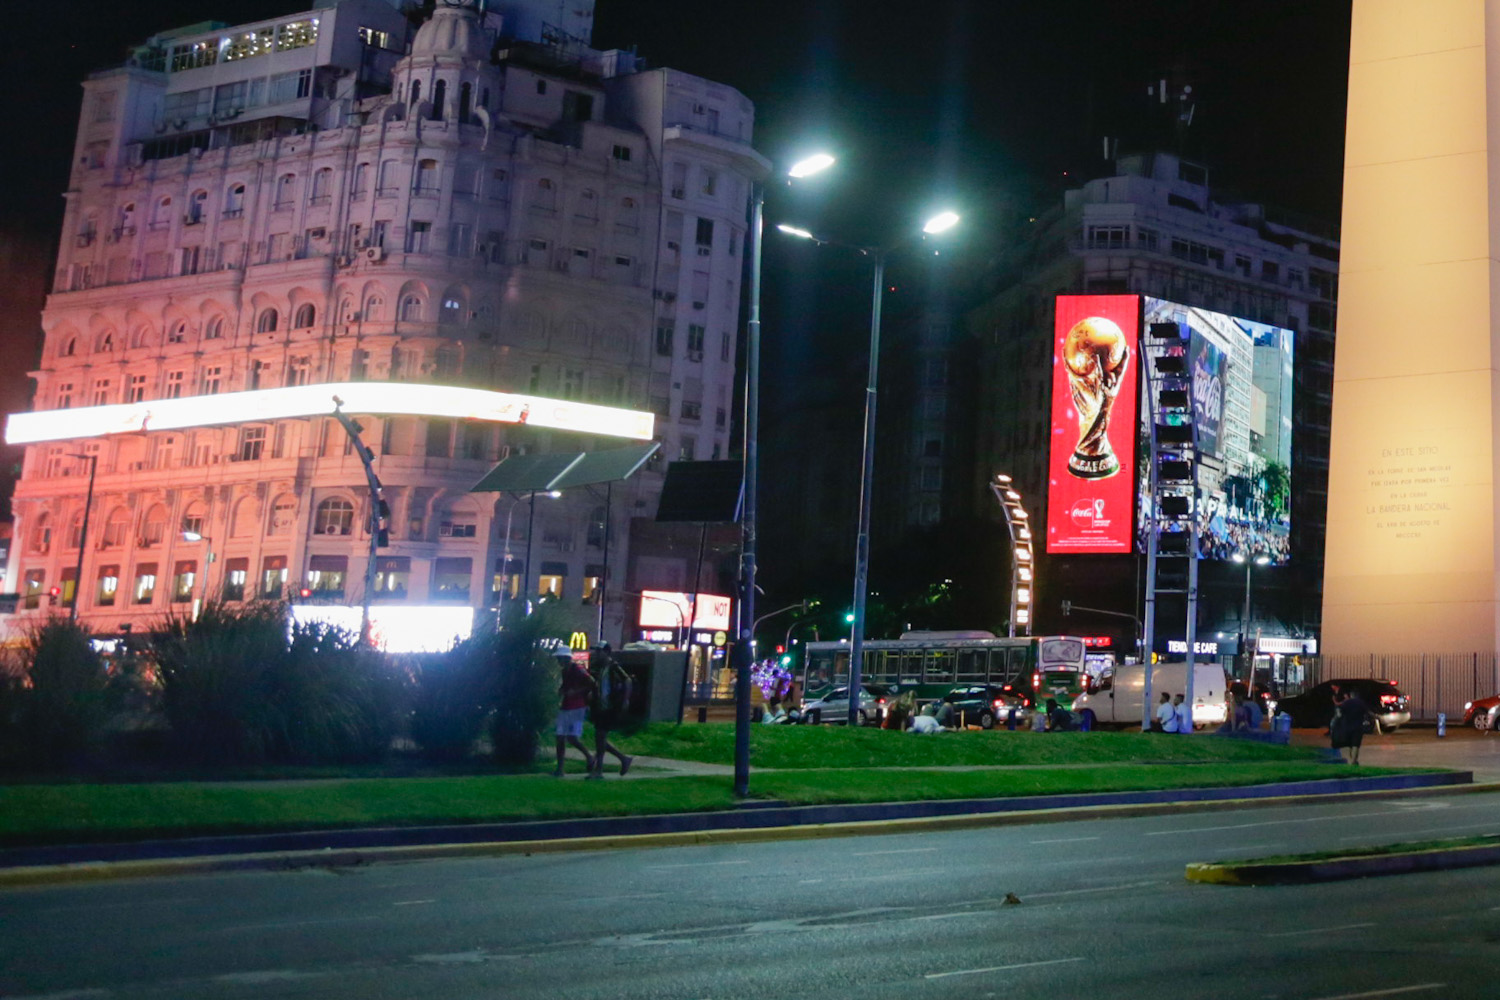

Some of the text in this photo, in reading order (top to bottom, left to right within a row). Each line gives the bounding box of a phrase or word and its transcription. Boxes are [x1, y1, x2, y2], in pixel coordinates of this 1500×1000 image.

[1381, 446, 1439, 458] EN ESTE SITIO
[1366, 501, 1452, 514] LA BANDERA NACIONAL
[1201, 643, 1217, 654] CAFE
